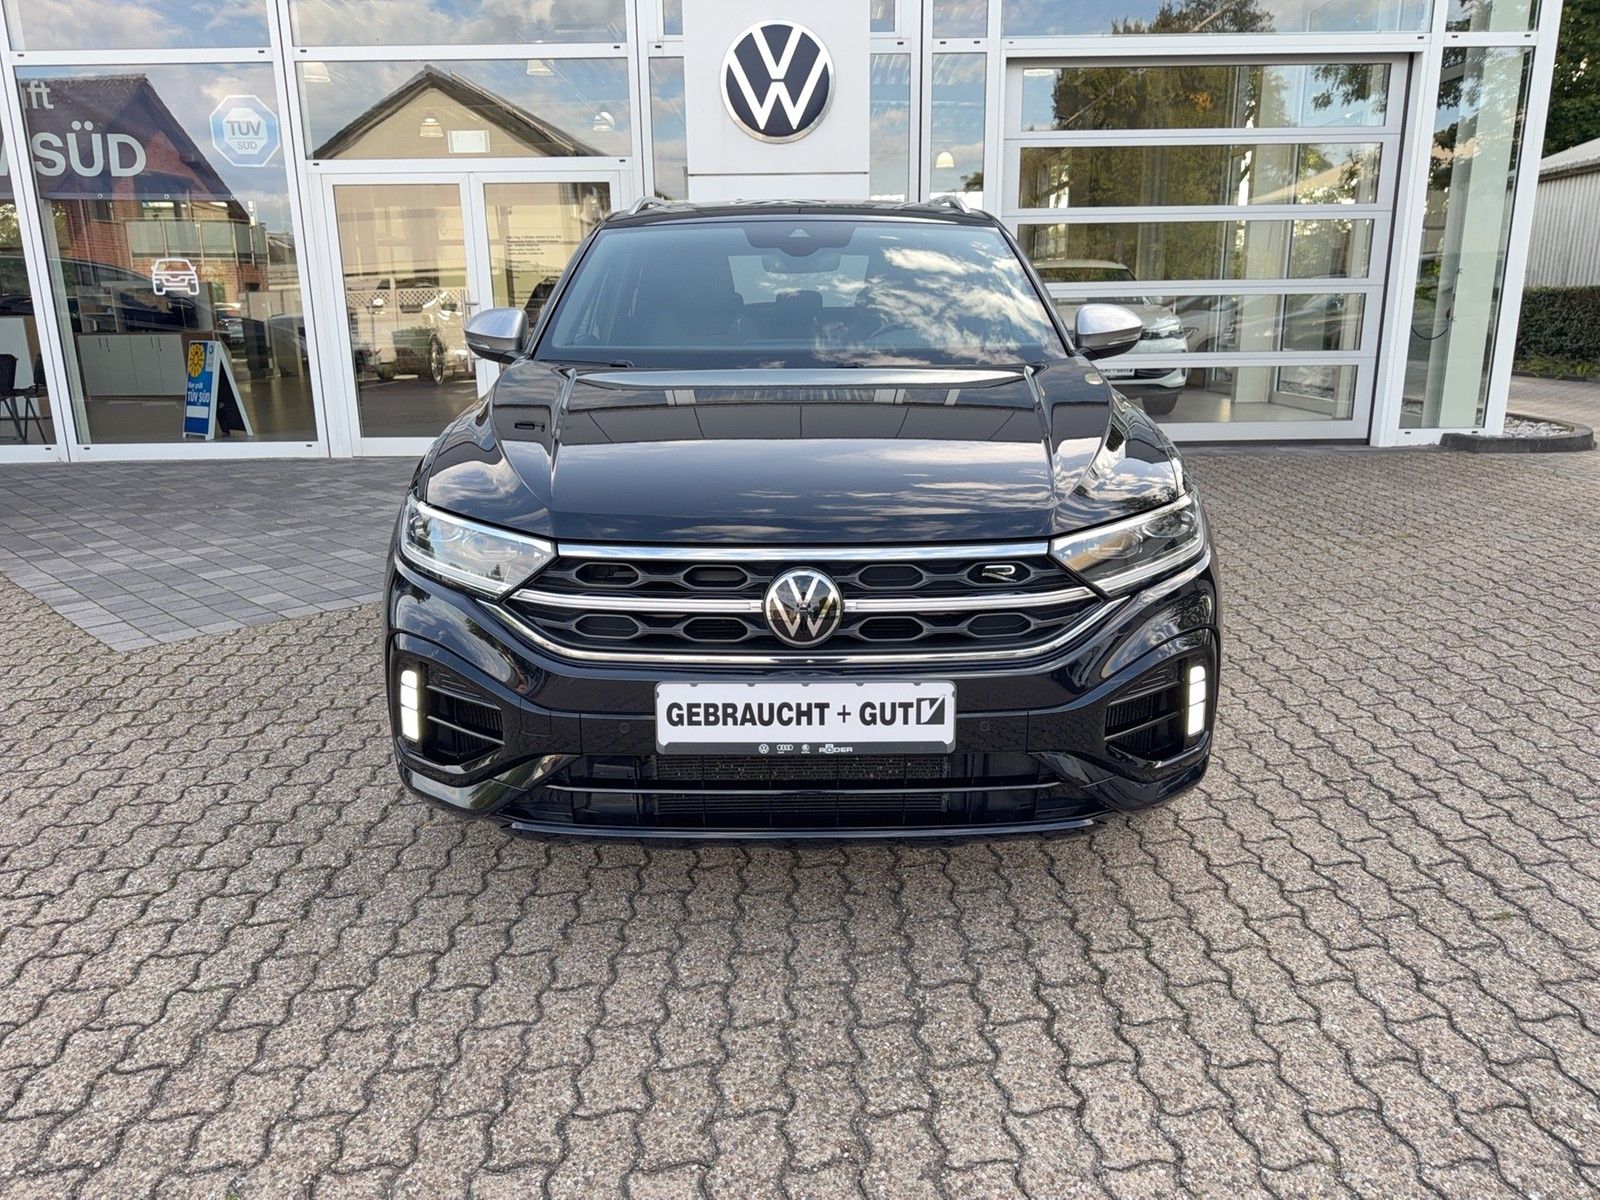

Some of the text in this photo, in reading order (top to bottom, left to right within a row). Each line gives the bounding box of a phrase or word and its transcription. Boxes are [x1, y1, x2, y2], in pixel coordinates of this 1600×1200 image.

[226, 119, 261, 136] TÜV
[31, 120, 146, 177] SÜD
[666, 701, 914, 727] GEBRAUCHT + GUT
